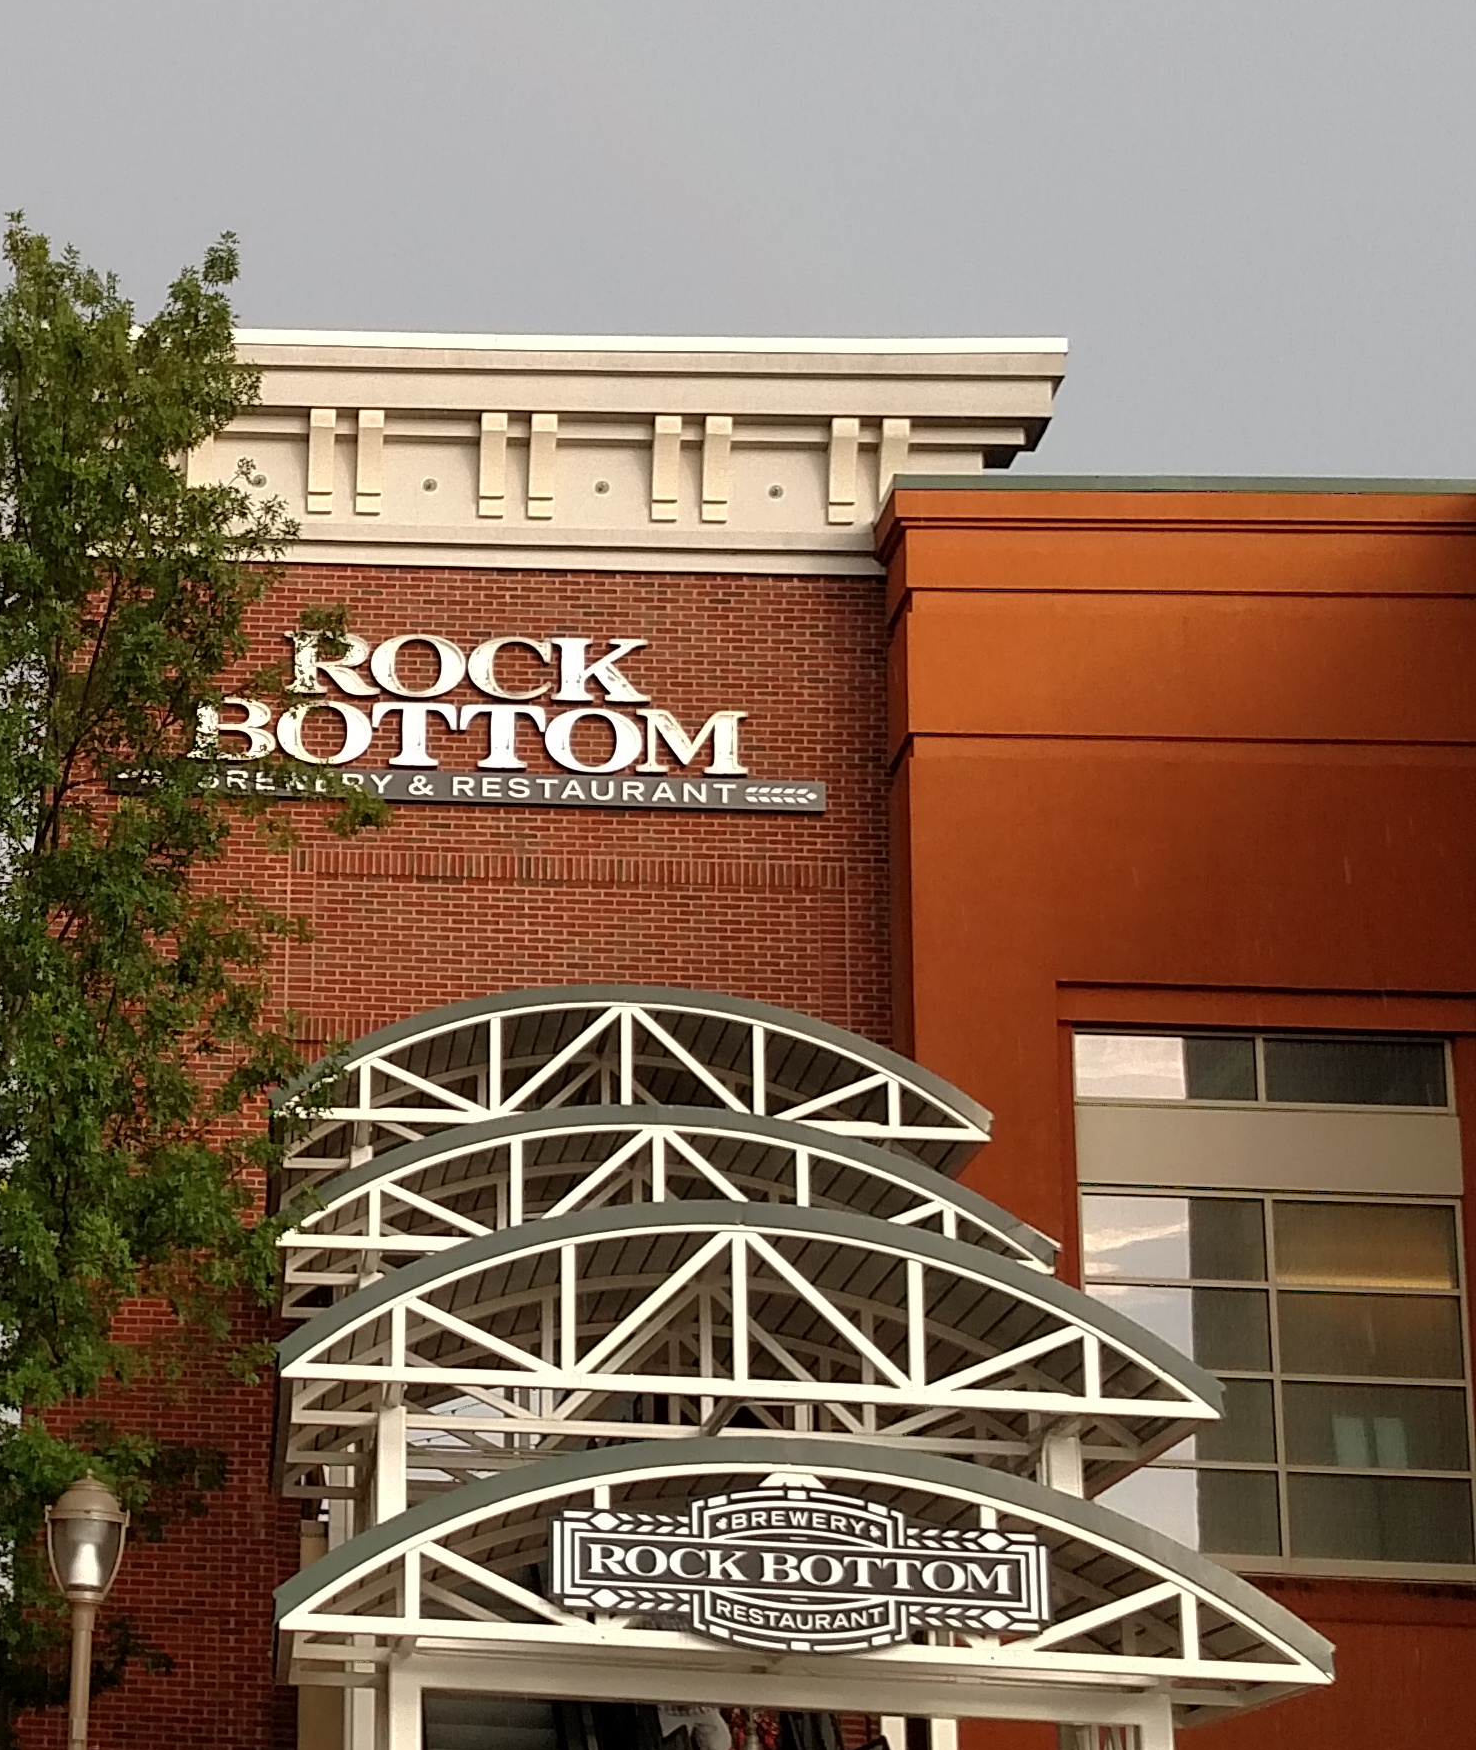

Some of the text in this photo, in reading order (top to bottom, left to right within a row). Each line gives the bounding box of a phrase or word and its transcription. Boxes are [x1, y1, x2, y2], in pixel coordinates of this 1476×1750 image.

[284, 630, 651, 701] ROCK
[187, 696, 748, 774] BOTTOM
[408, 775, 435, 796] &
[452, 776, 737, 804] RESTAURANT
[731, 1510, 866, 1535] BREWERY
[587, 1543, 1013, 1595] ROCK BOTTOM
[716, 1598, 886, 1630] RESTAURANT
